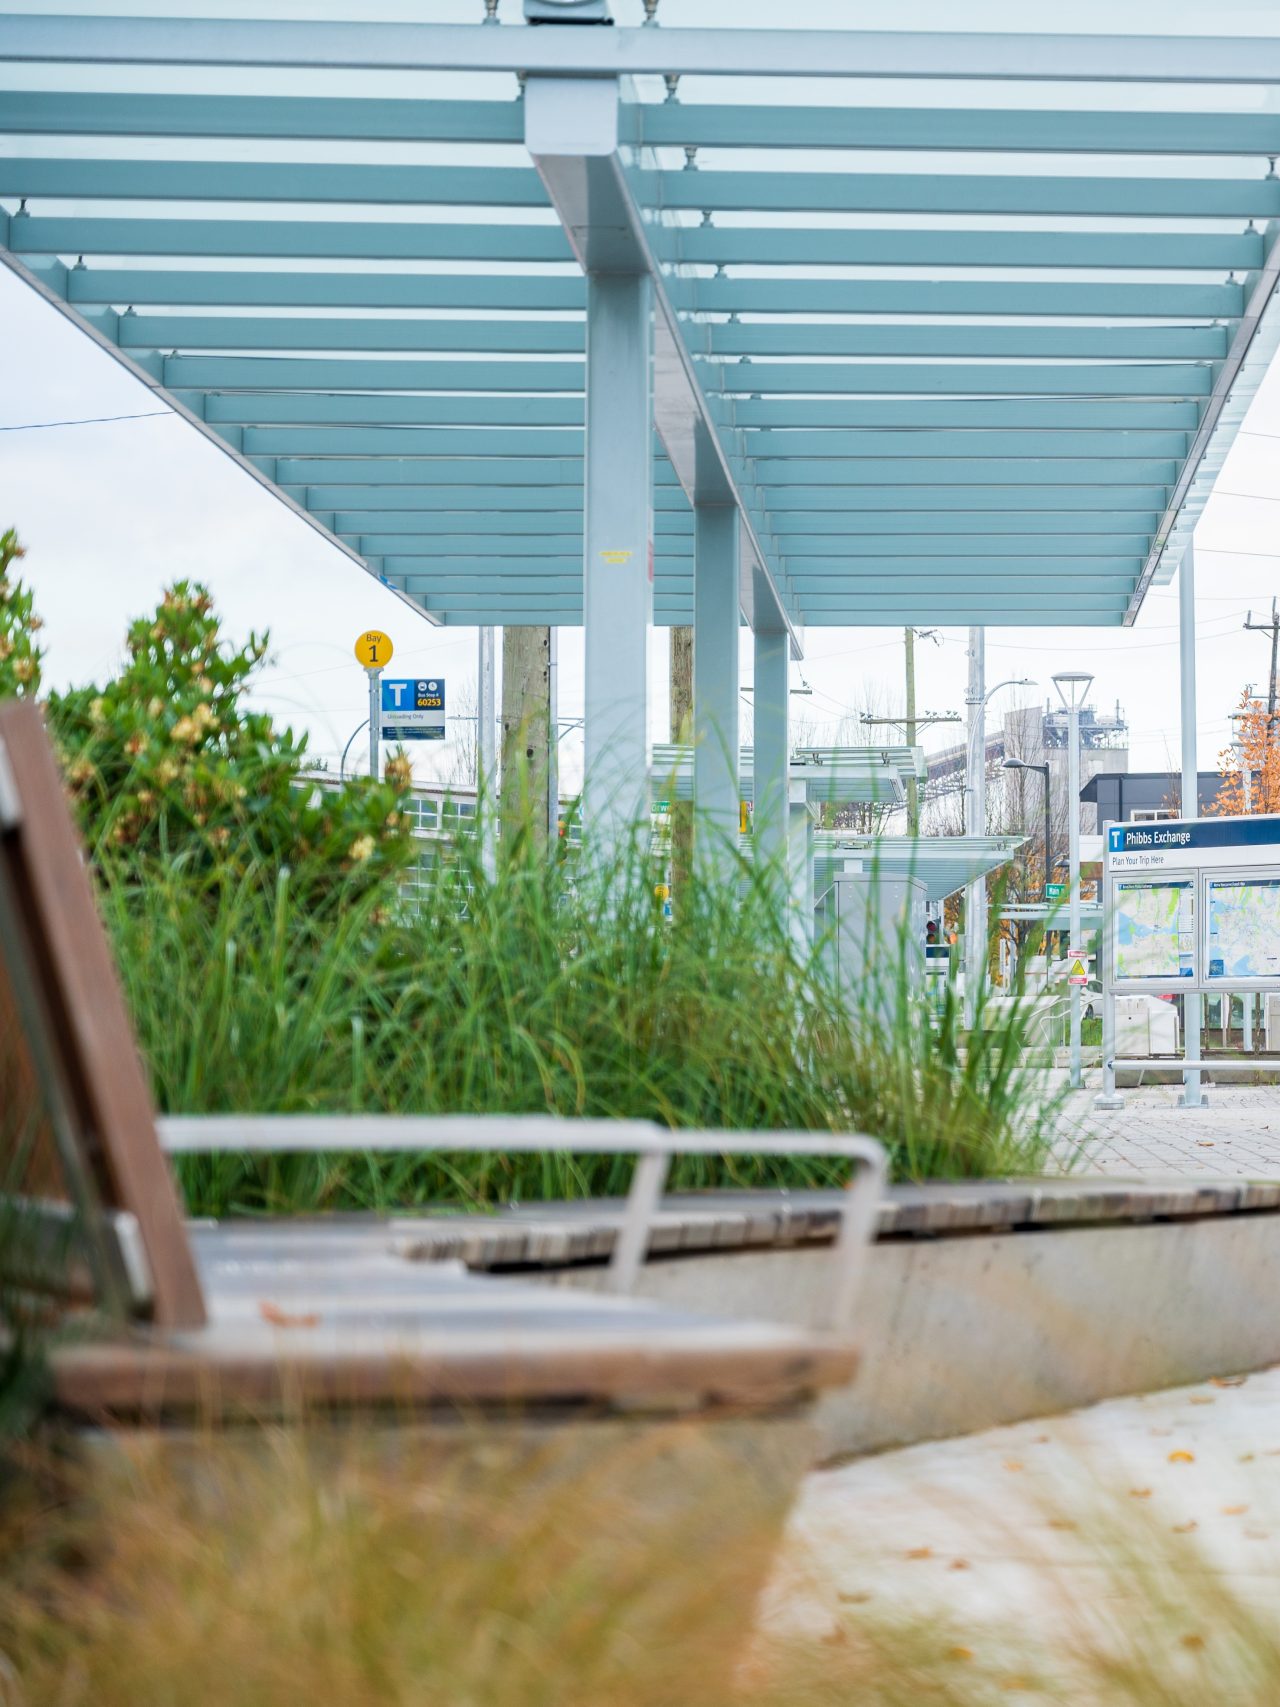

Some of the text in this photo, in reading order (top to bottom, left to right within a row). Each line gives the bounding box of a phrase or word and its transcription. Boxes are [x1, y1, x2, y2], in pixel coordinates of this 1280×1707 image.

[366, 634, 381, 643] Bay
[369, 645, 378, 662] 1
[389, 683, 407, 706] T
[417, 698, 441, 706] 60253
[1112, 831, 1120, 848] T
[1126, 830, 1190, 845] Phibbs Exchange
[1112, 855, 1164, 866] Plan Your Trip Here
